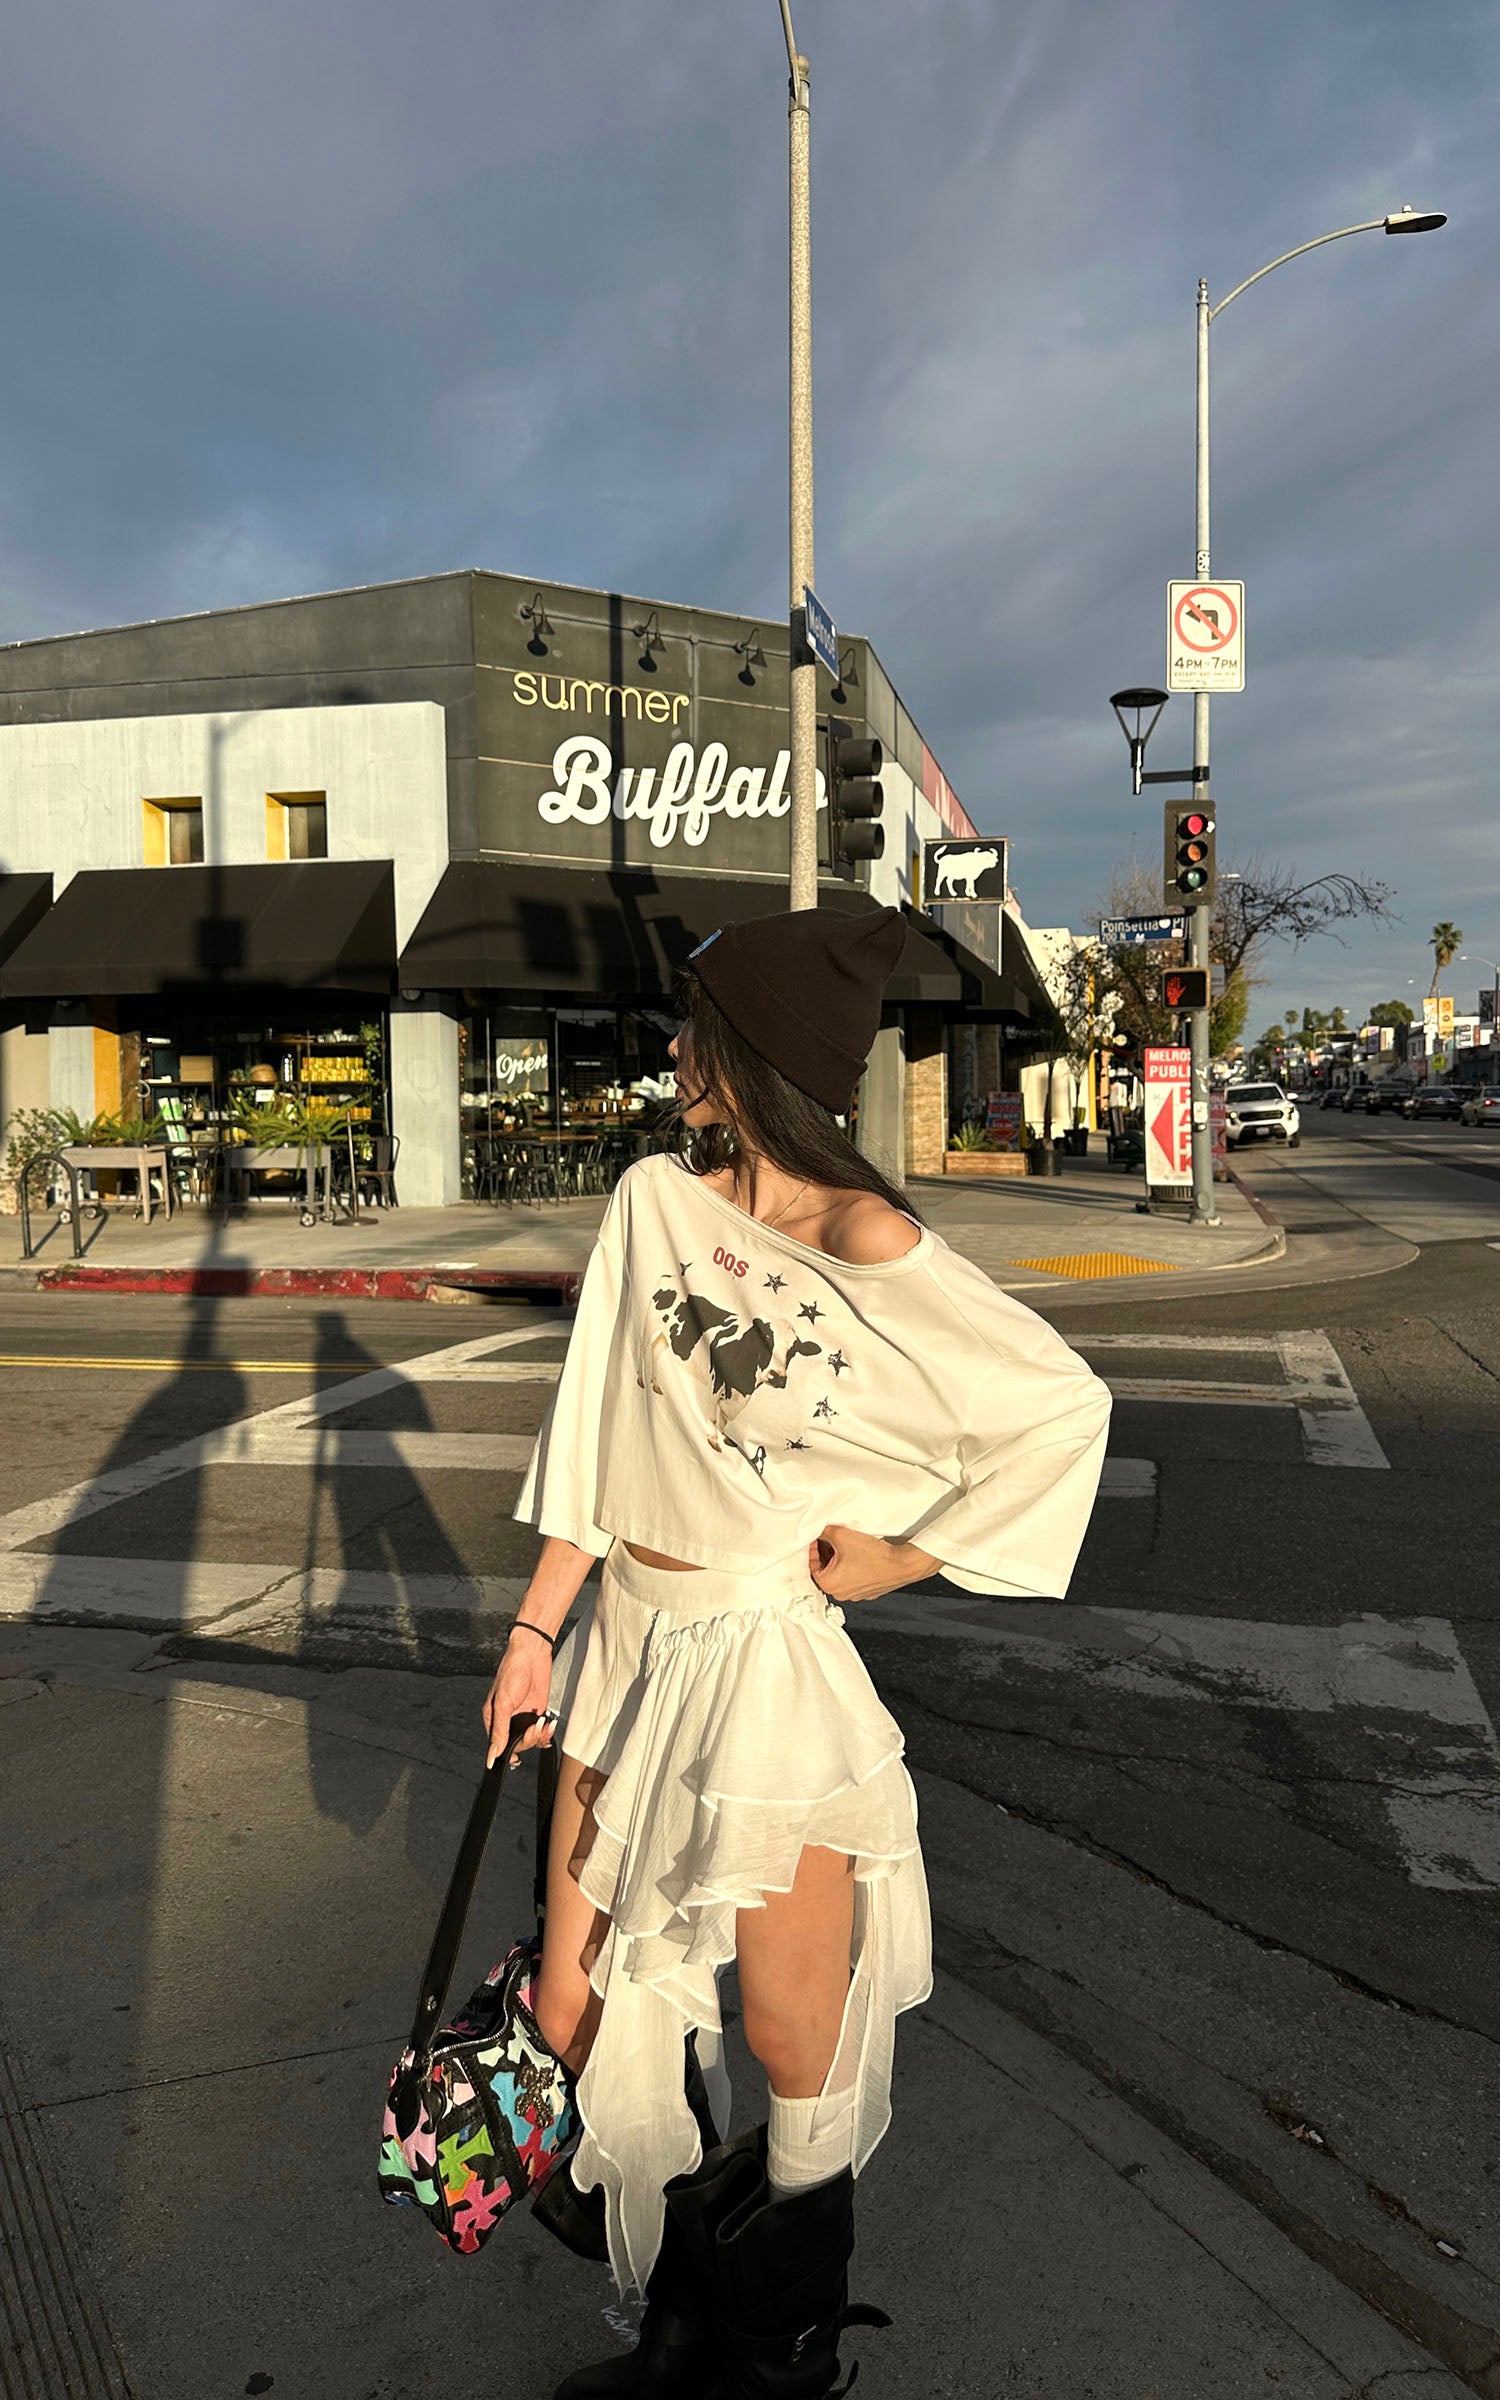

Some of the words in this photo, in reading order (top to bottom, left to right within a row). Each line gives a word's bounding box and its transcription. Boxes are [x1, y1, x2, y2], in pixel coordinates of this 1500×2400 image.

[513, 671, 690, 725] summer
[1101, 919, 1159, 933] Poinsettia
[1172, 917, 1184, 929] Pl
[1102, 931, 1117, 941] 700
[1149, 1050, 1191, 1062] MELRO
[496, 1053, 549, 1084] Open
[1150, 1065, 1191, 1078] PUBLI
